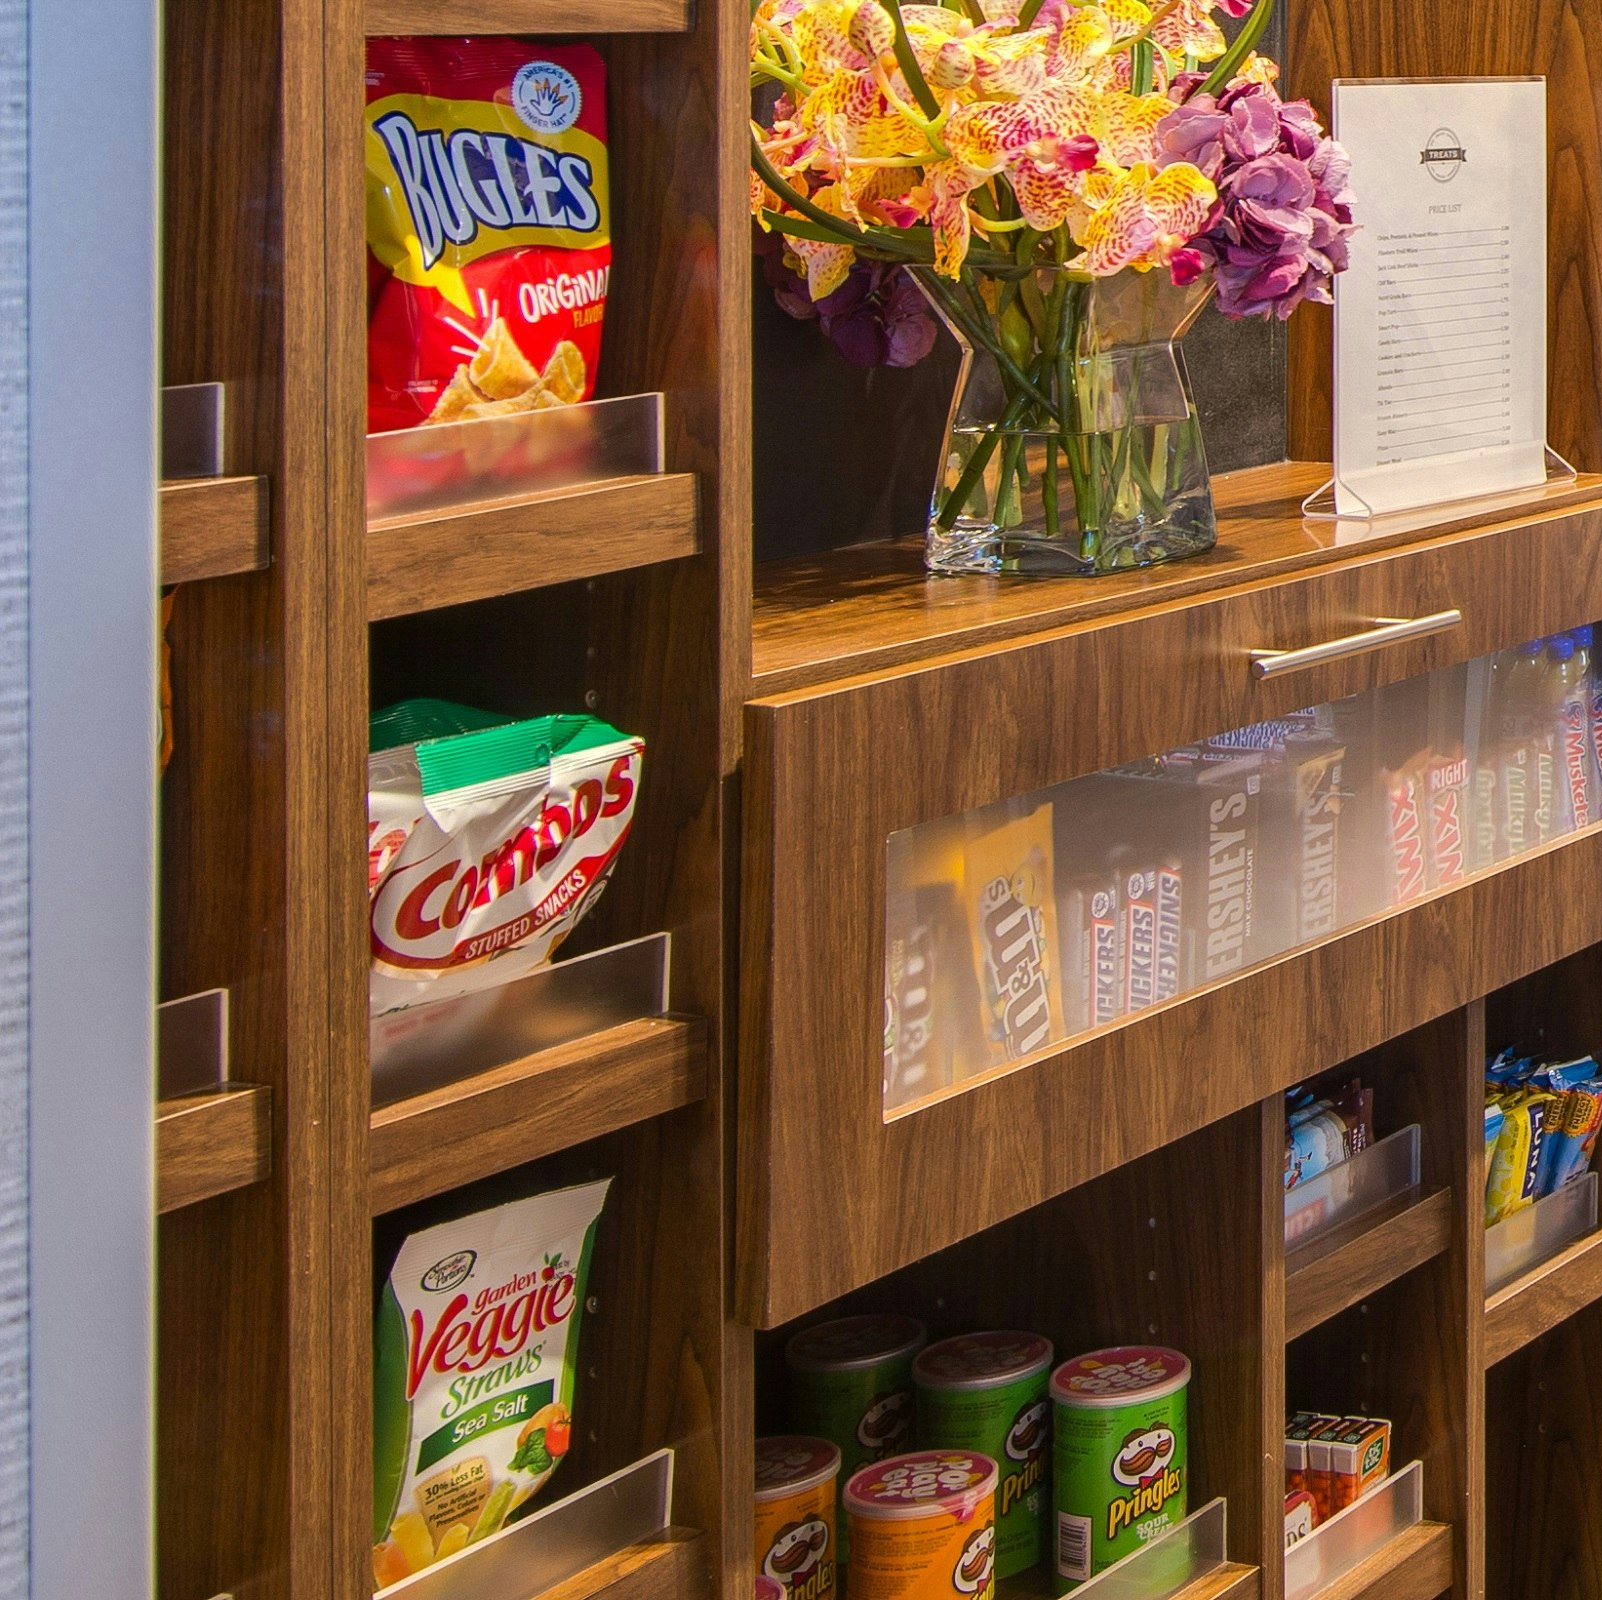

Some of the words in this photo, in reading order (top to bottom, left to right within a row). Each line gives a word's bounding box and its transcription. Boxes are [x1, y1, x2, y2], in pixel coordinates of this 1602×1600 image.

[521, 105, 549, 129] FINGER
[1429, 150, 1458, 159] TREATS
[374, 112, 600, 271] BUGLES
[1429, 205, 1447, 215] PRICE
[1448, 204, 1462, 214] LIST
[1431, 759, 1468, 791] RIGHT
[465, 916, 531, 960] STUFFED
[534, 868, 588, 927] SNACKS
[1527, 1111, 1545, 1190] LUNA
[471, 1270, 537, 1316] garden
[406, 1274, 577, 1401] Veggie
[440, 1343, 544, 1420] Straws
[452, 1413, 487, 1444] Sea
[492, 1394, 529, 1423] Salt
[424, 1480, 449, 1500] 30%
[451, 1470, 469, 1488] Less
[470, 1463, 483, 1478] Fat
[1107, 1467, 1182, 1539] Pringles
[1136, 1512, 1169, 1536] SOUR
